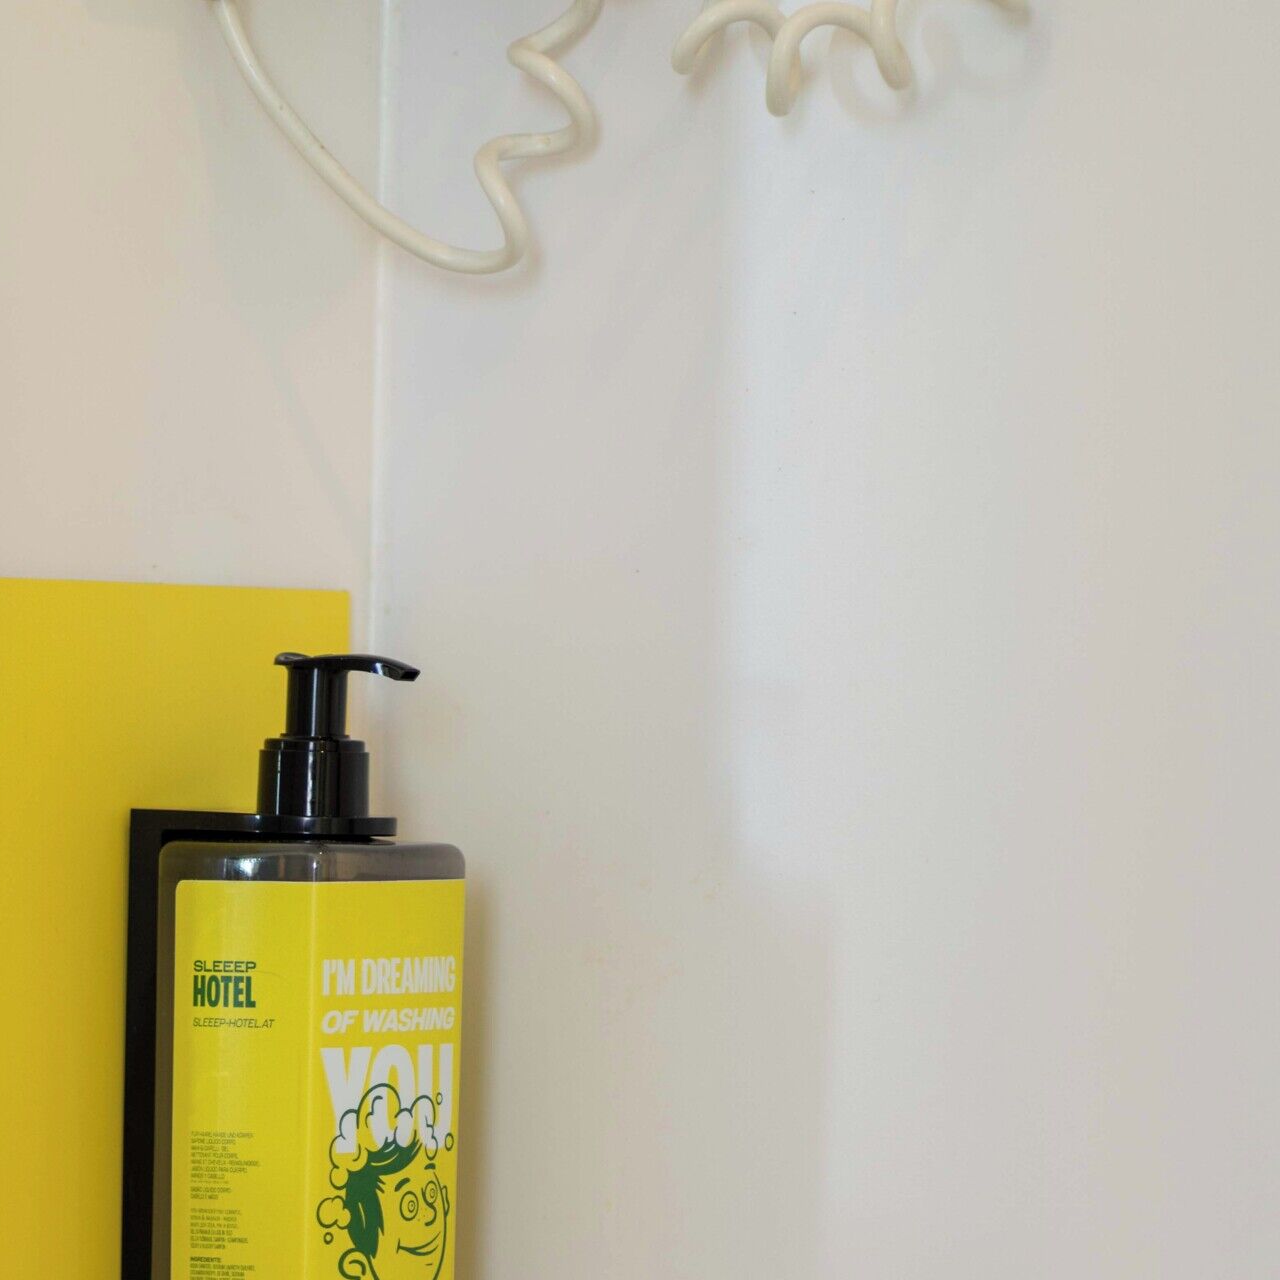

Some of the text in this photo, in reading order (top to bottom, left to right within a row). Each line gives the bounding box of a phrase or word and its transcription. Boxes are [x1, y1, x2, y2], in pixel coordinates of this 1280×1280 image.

[193, 960, 257, 973] SLEEEP
[322, 955, 456, 996] I'M DREAMING
[193, 974, 256, 1008] HOTEL
[193, 1016, 275, 1029] SLEEEP-HOTEL.AT
[321, 1006, 456, 1034] OF WASHING
[320, 1042, 454, 1154] YOU
